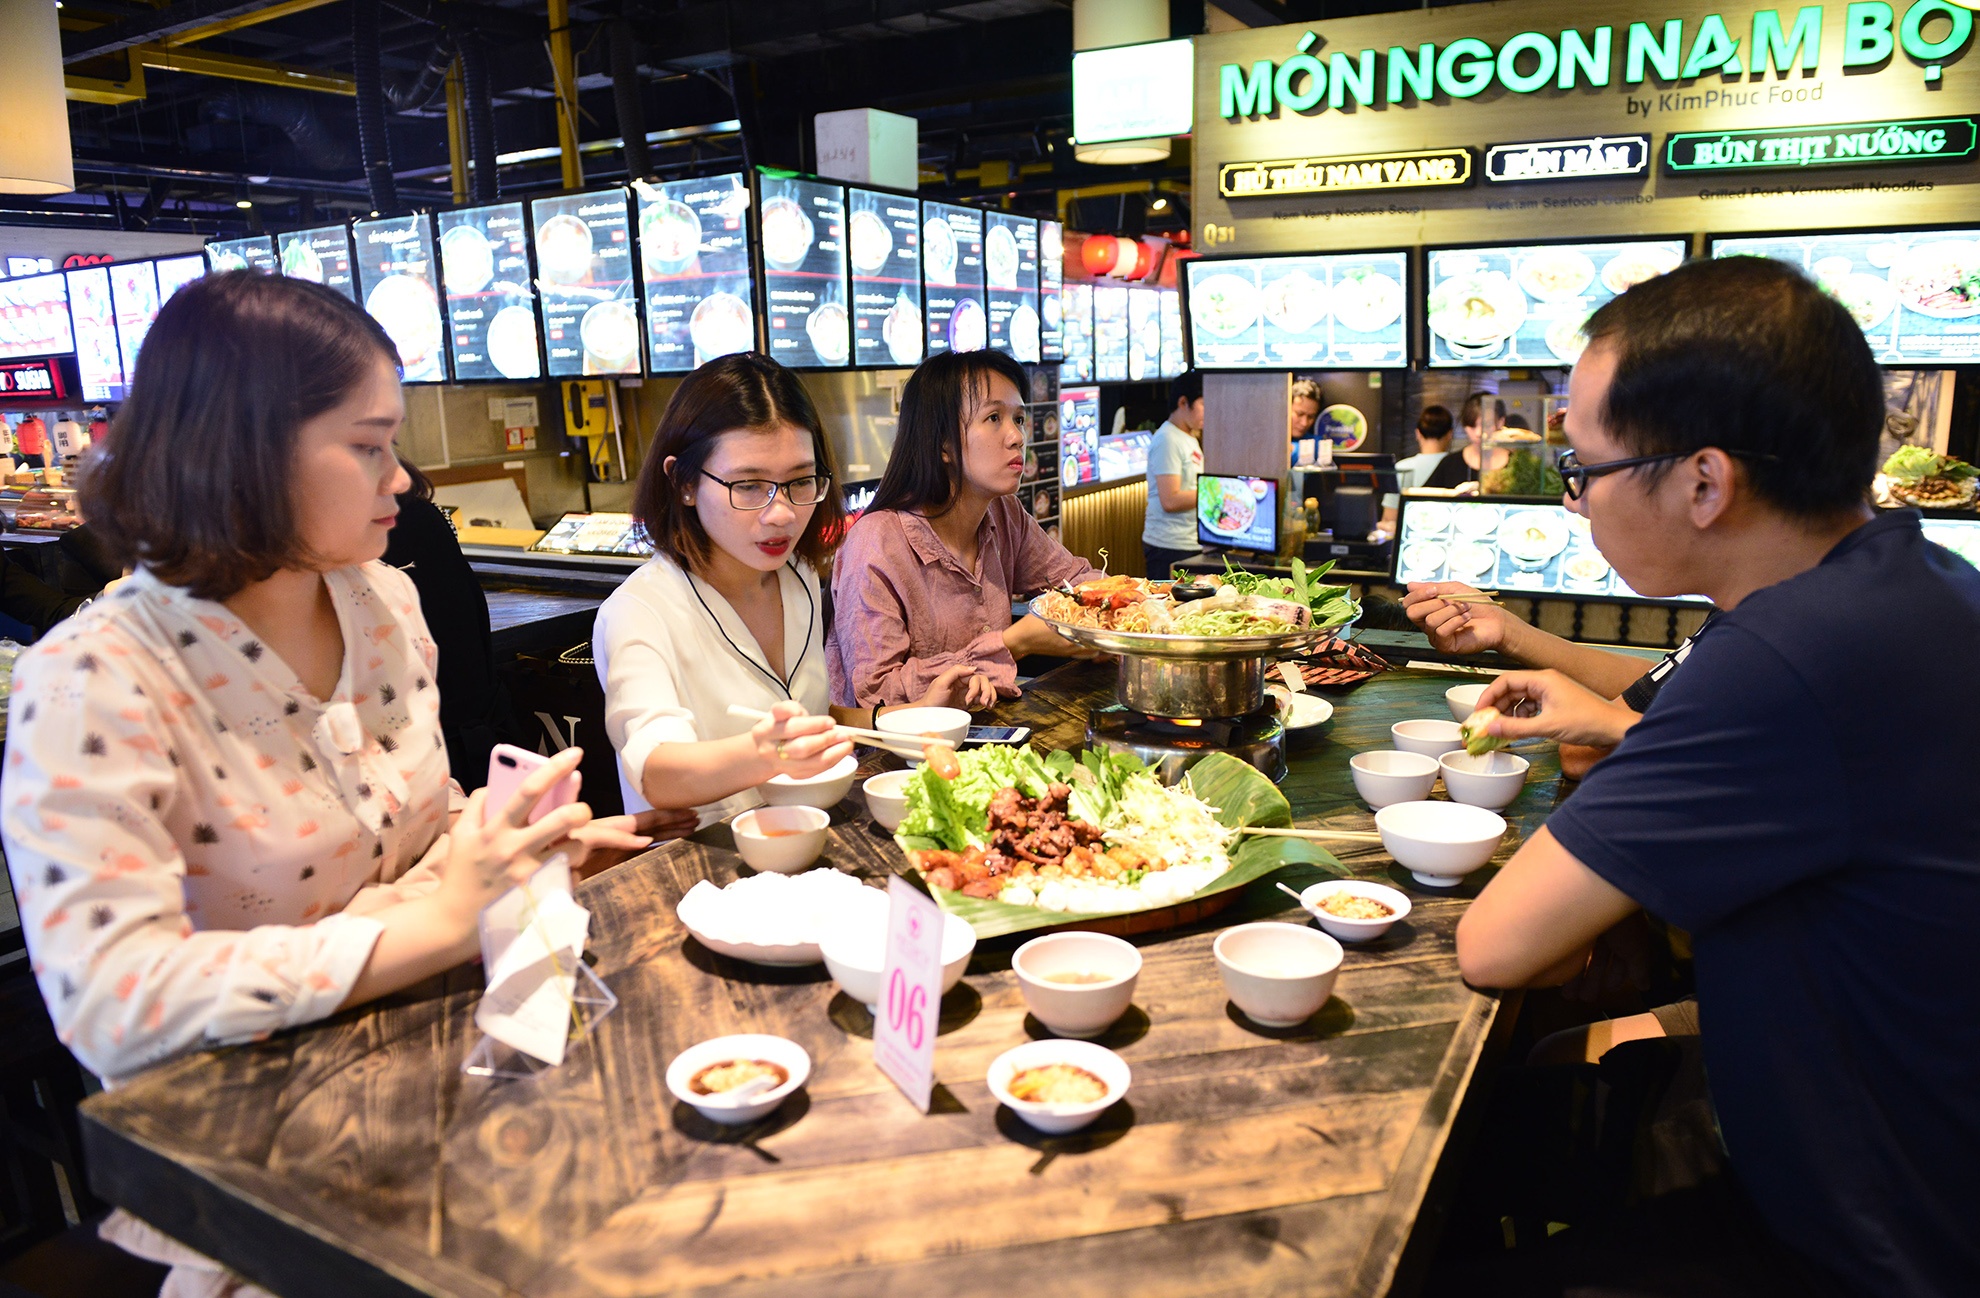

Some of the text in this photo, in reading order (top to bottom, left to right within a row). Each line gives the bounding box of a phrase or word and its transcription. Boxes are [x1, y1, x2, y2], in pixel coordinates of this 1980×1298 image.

[1220, 31, 1375, 118] MÓN
[1387, 26, 1612, 103] NGON
[1626, 5, 1823, 83] NAM
[1627, 82, 1823, 118] by KimPhuc Food
[1694, 125, 1946, 166] BÚN THỊT NƯỚNG
[1326, 163, 1382, 186] NAM
[1383, 158, 1457, 182] VANG
[1542, 196, 1598, 208] Seafood
[1700, 179, 1934, 200] Grilled Pork Vermicelli Noodles
[1336, 205, 1384, 217] Noodles
[1389, 203, 1420, 216] Soup
[888, 967, 927, 1051] 06
